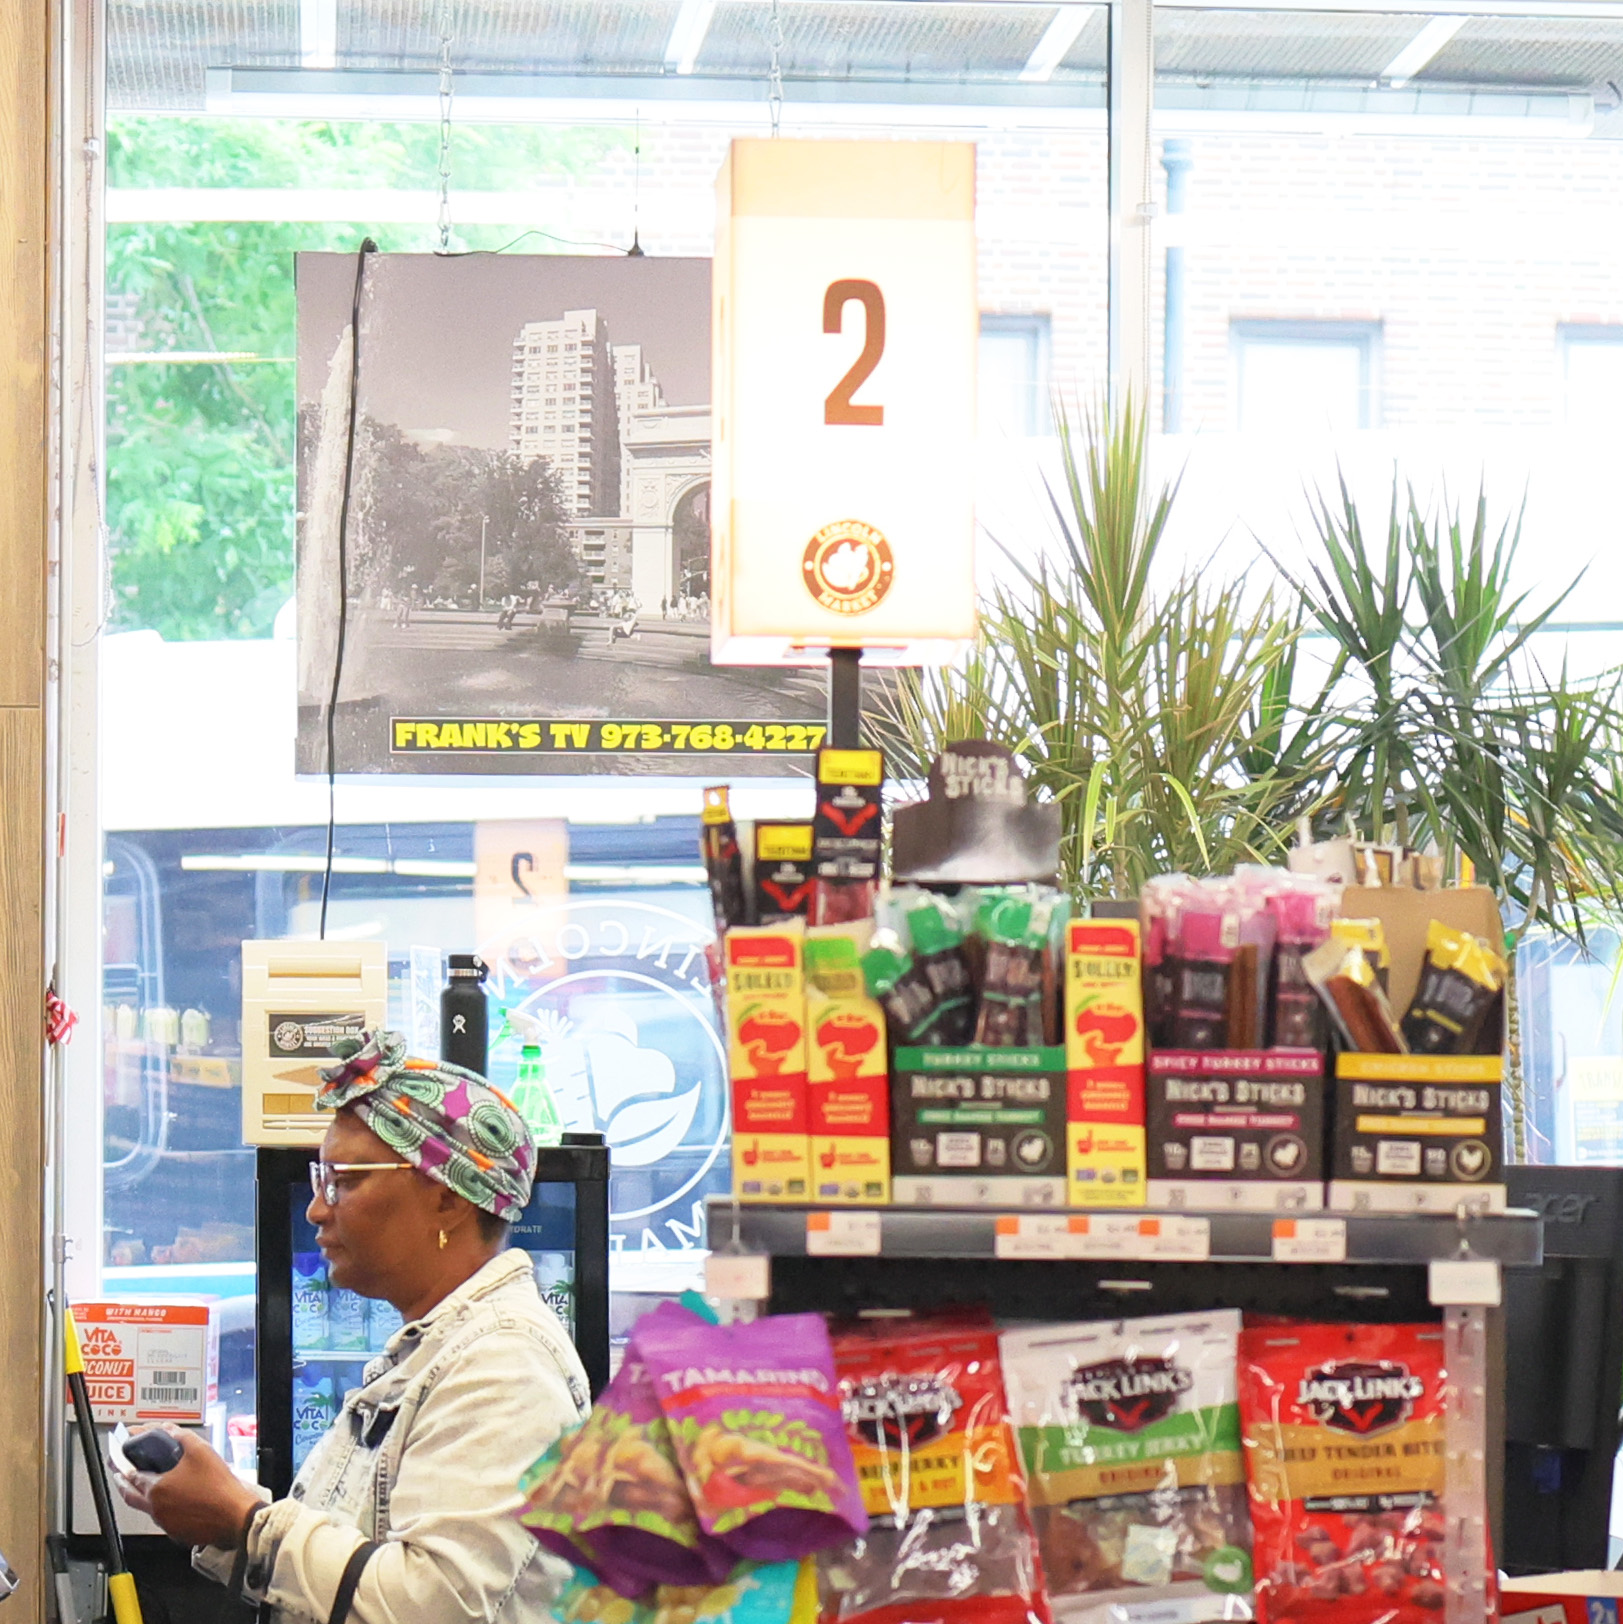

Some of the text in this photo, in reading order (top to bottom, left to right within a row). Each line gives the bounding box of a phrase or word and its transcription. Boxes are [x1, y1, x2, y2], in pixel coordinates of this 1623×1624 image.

[822, 278, 886, 426] 2
[394, 722, 541, 750] FRANK'S
[549, 722, 591, 748] TV
[511, 1225, 542, 1234] YDRATE
[542, 1293, 568, 1305] VITA
[106, 1308, 167, 1317] WITH MANGO
[84, 1328, 117, 1343] VITA
[82, 1344, 122, 1356] COCO
[1067, 1364, 1192, 1402] JACK LINK'S
[88, 1386, 125, 1399] UICE
[1402, 1440, 1445, 1458] BITE
